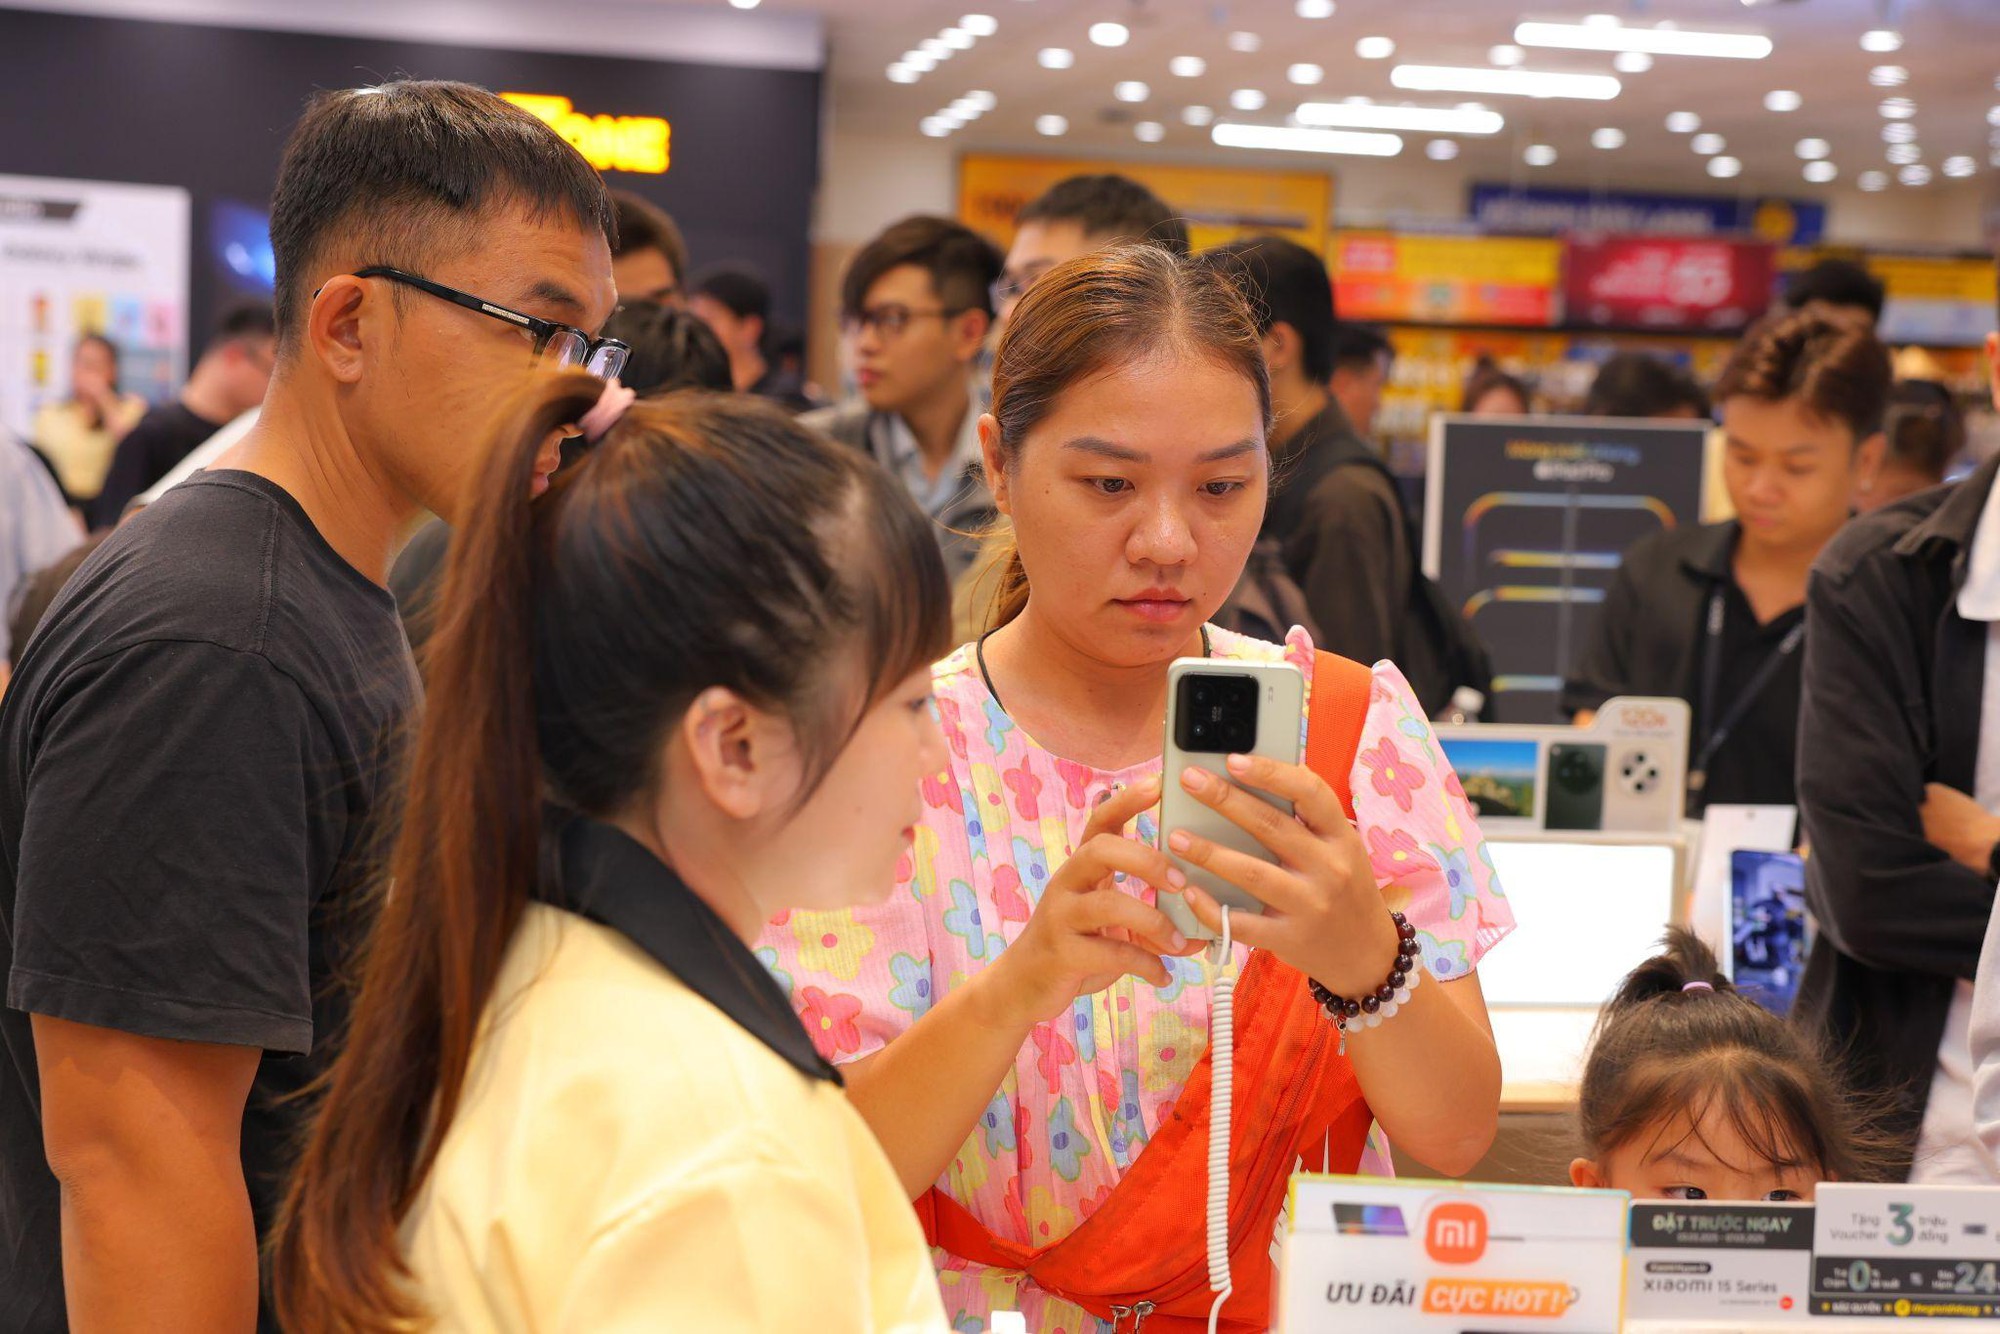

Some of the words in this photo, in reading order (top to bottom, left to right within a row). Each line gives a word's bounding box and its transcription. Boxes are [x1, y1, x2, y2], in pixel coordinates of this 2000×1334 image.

[1652, 1212, 1686, 1234] ĐẶT
[1746, 1216, 1793, 1233] NGAY
[1830, 1229, 1878, 1240] Voucher
[1886, 1202, 1914, 1246] 3
[1717, 1280, 1731, 1293] 15
[1737, 1280, 1777, 1293] Series
[1849, 1260, 1871, 1293] 0
[1954, 1261, 1997, 1294] 24
[1326, 1282, 1363, 1303] ƯU
[1371, 1279, 1415, 1305] ĐÃI
[1429, 1285, 1487, 1313] CỰC
